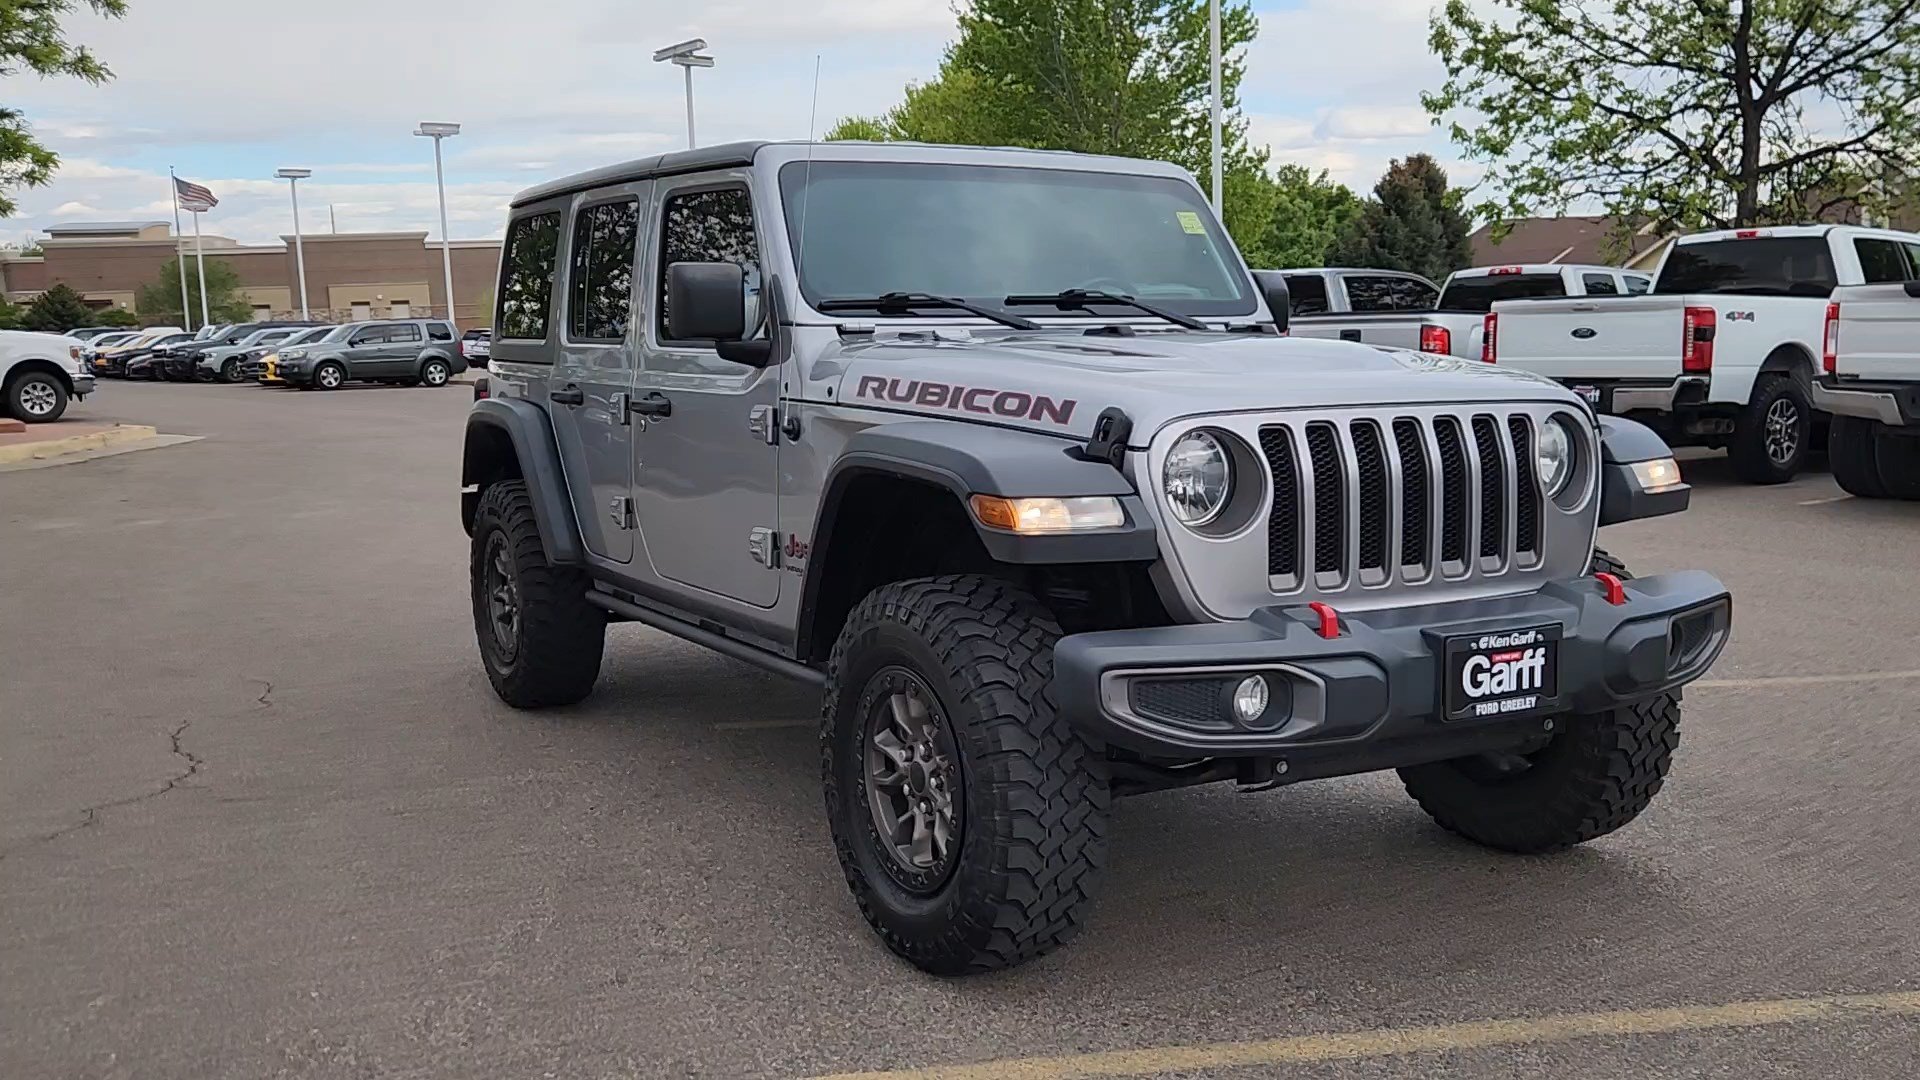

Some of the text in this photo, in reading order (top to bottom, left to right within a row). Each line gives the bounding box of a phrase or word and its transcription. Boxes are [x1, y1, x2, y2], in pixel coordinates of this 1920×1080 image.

[856, 375, 1077, 425] RUBICON
[1463, 647, 1545, 697] Garff
[1475, 696, 1537, 716] FORD GREELEY
